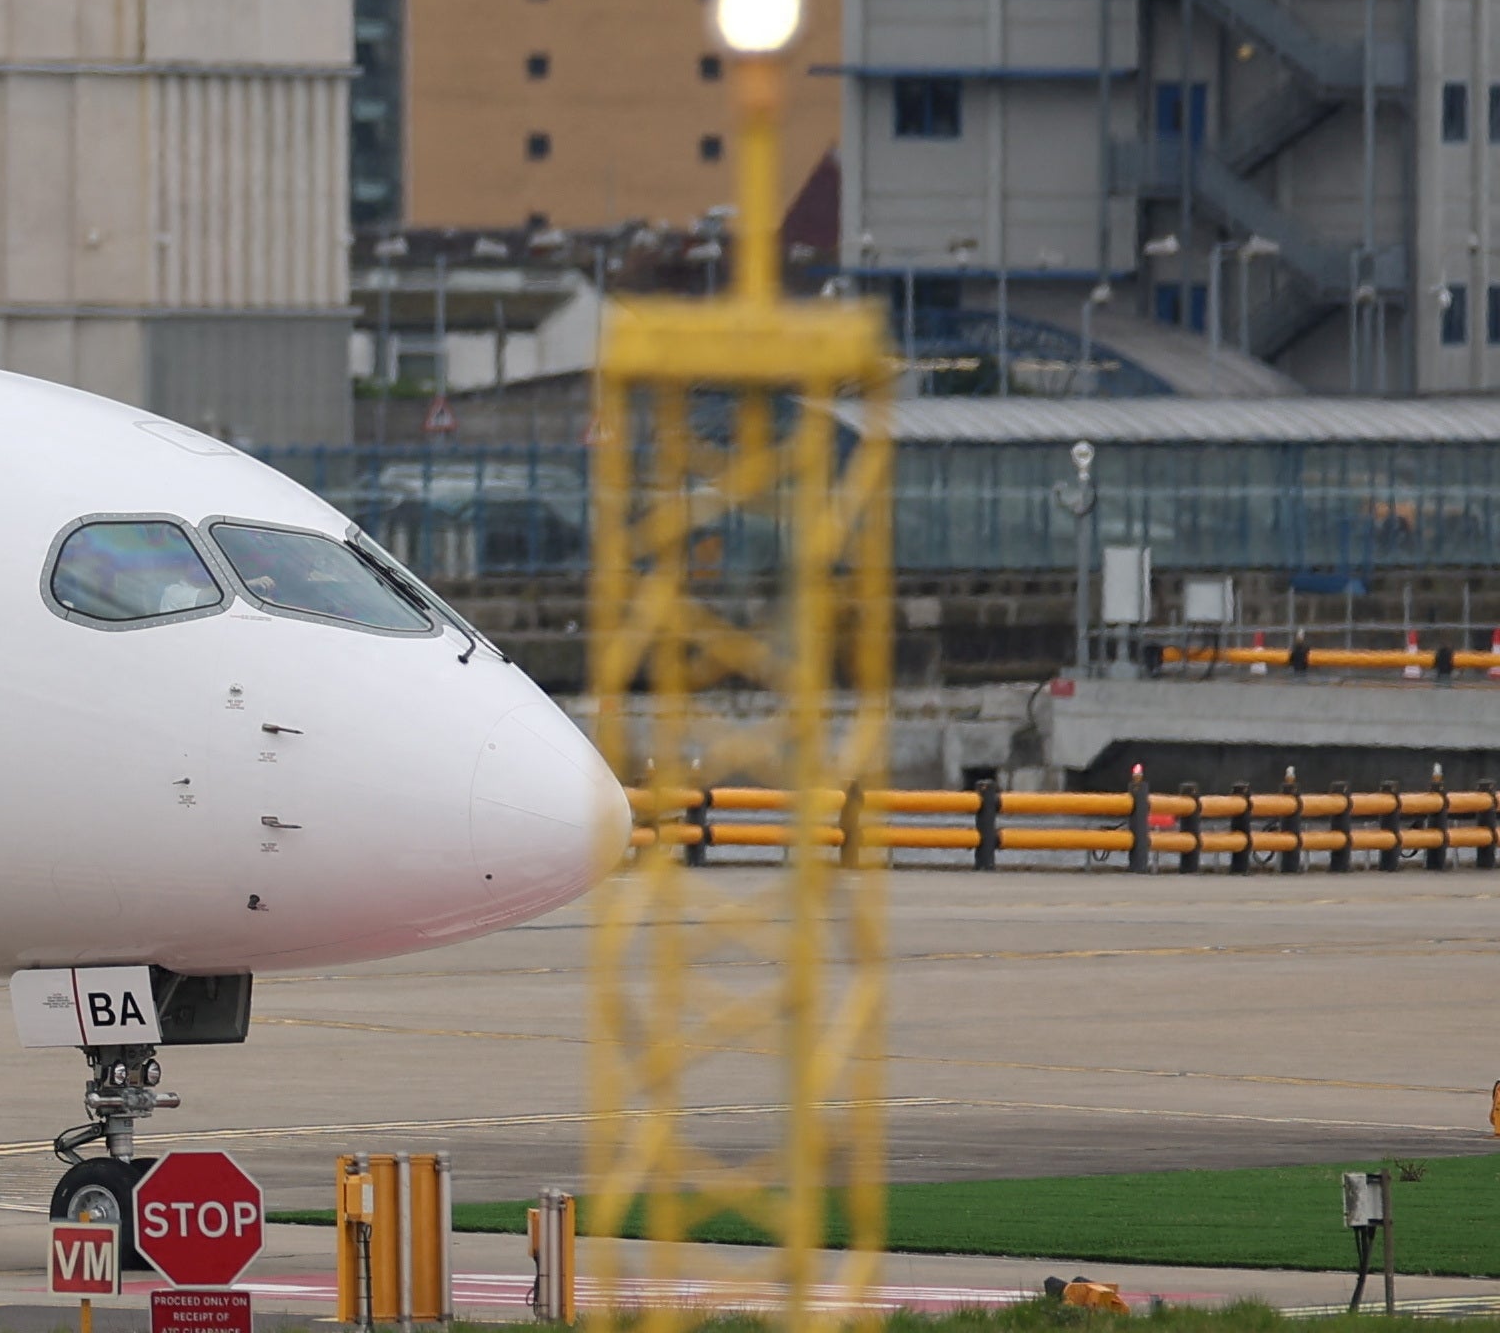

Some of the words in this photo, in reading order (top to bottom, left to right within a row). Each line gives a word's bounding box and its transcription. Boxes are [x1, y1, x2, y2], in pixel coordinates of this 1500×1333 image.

[87, 991, 147, 1027] BA
[144, 1201, 258, 1238] STOP
[54, 1240, 113, 1282] VM
[154, 1296, 201, 1306] PROCEED
[203, 1296, 230, 1306] ONLY
[231, 1297, 248, 1307] ON
[172, 1312, 214, 1322] RECEIPT
[216, 1312, 230, 1322] OF
